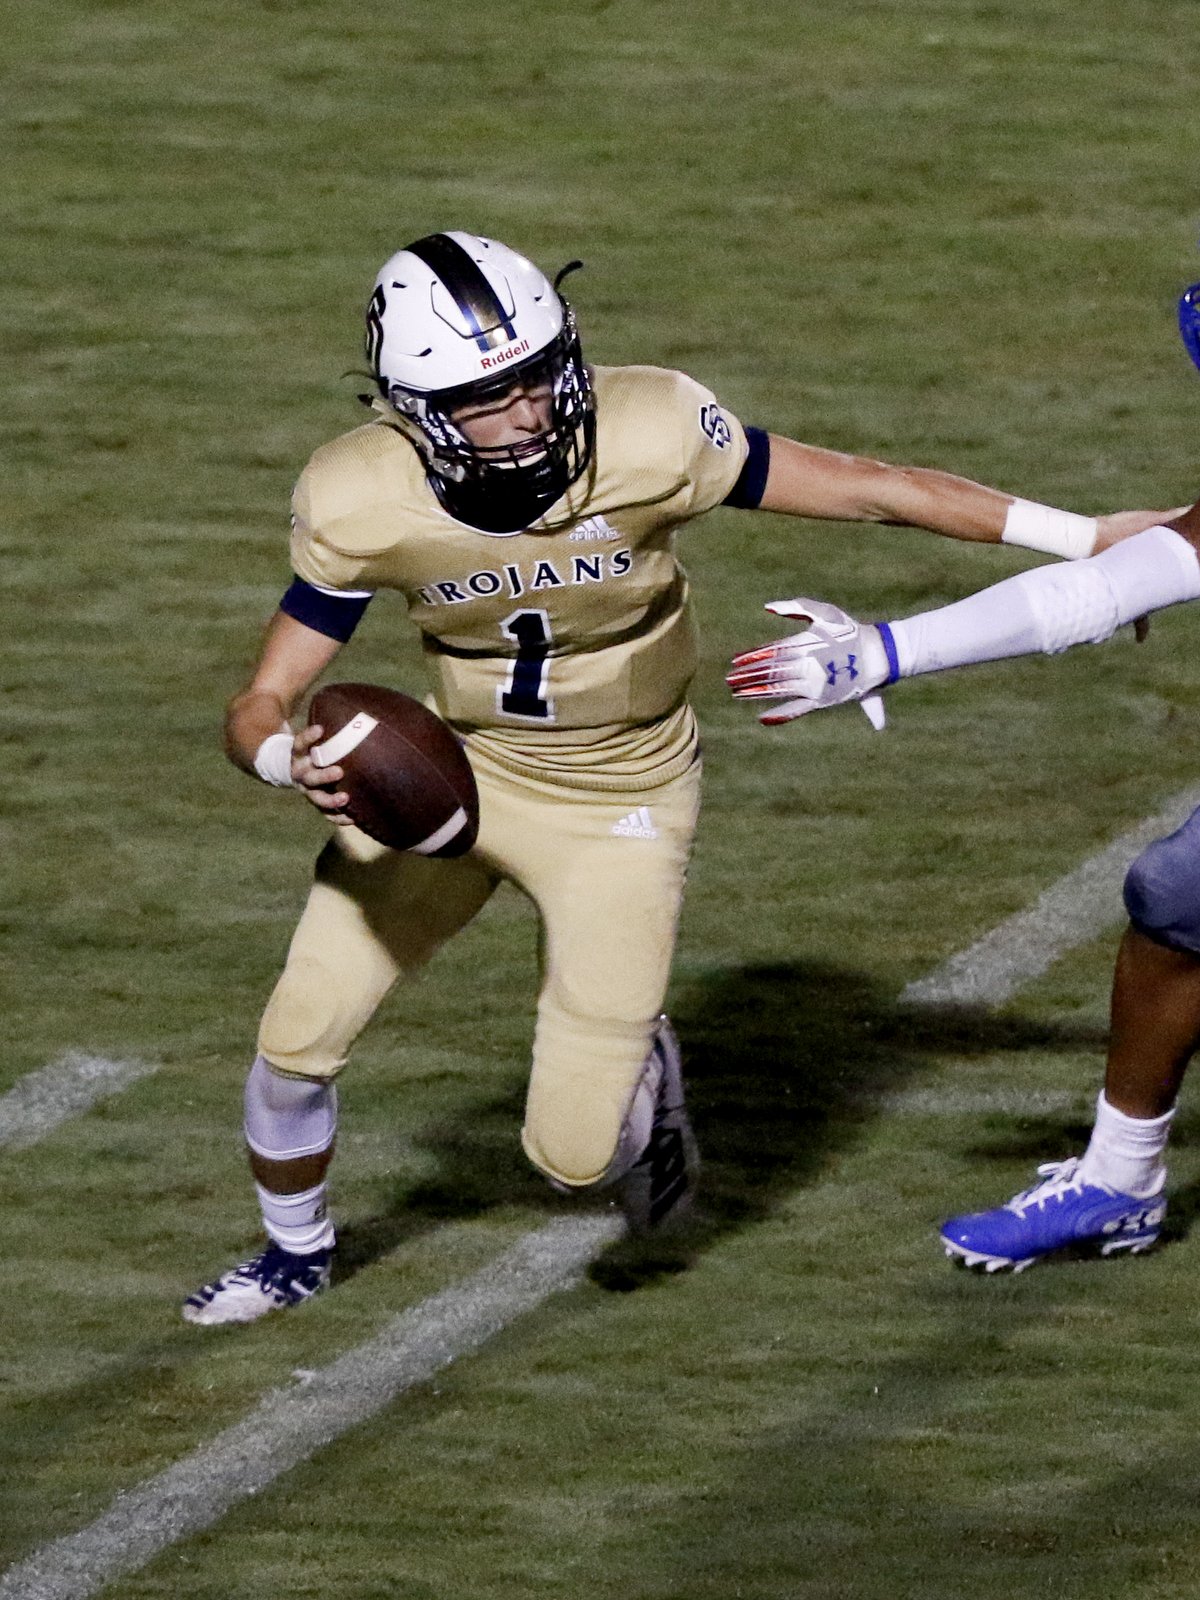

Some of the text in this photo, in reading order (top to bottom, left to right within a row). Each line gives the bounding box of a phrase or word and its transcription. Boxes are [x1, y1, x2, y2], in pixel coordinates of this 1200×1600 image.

[480, 340, 530, 370] Riddell
[568, 527, 621, 542] adidas
[497, 609, 554, 721] 1
